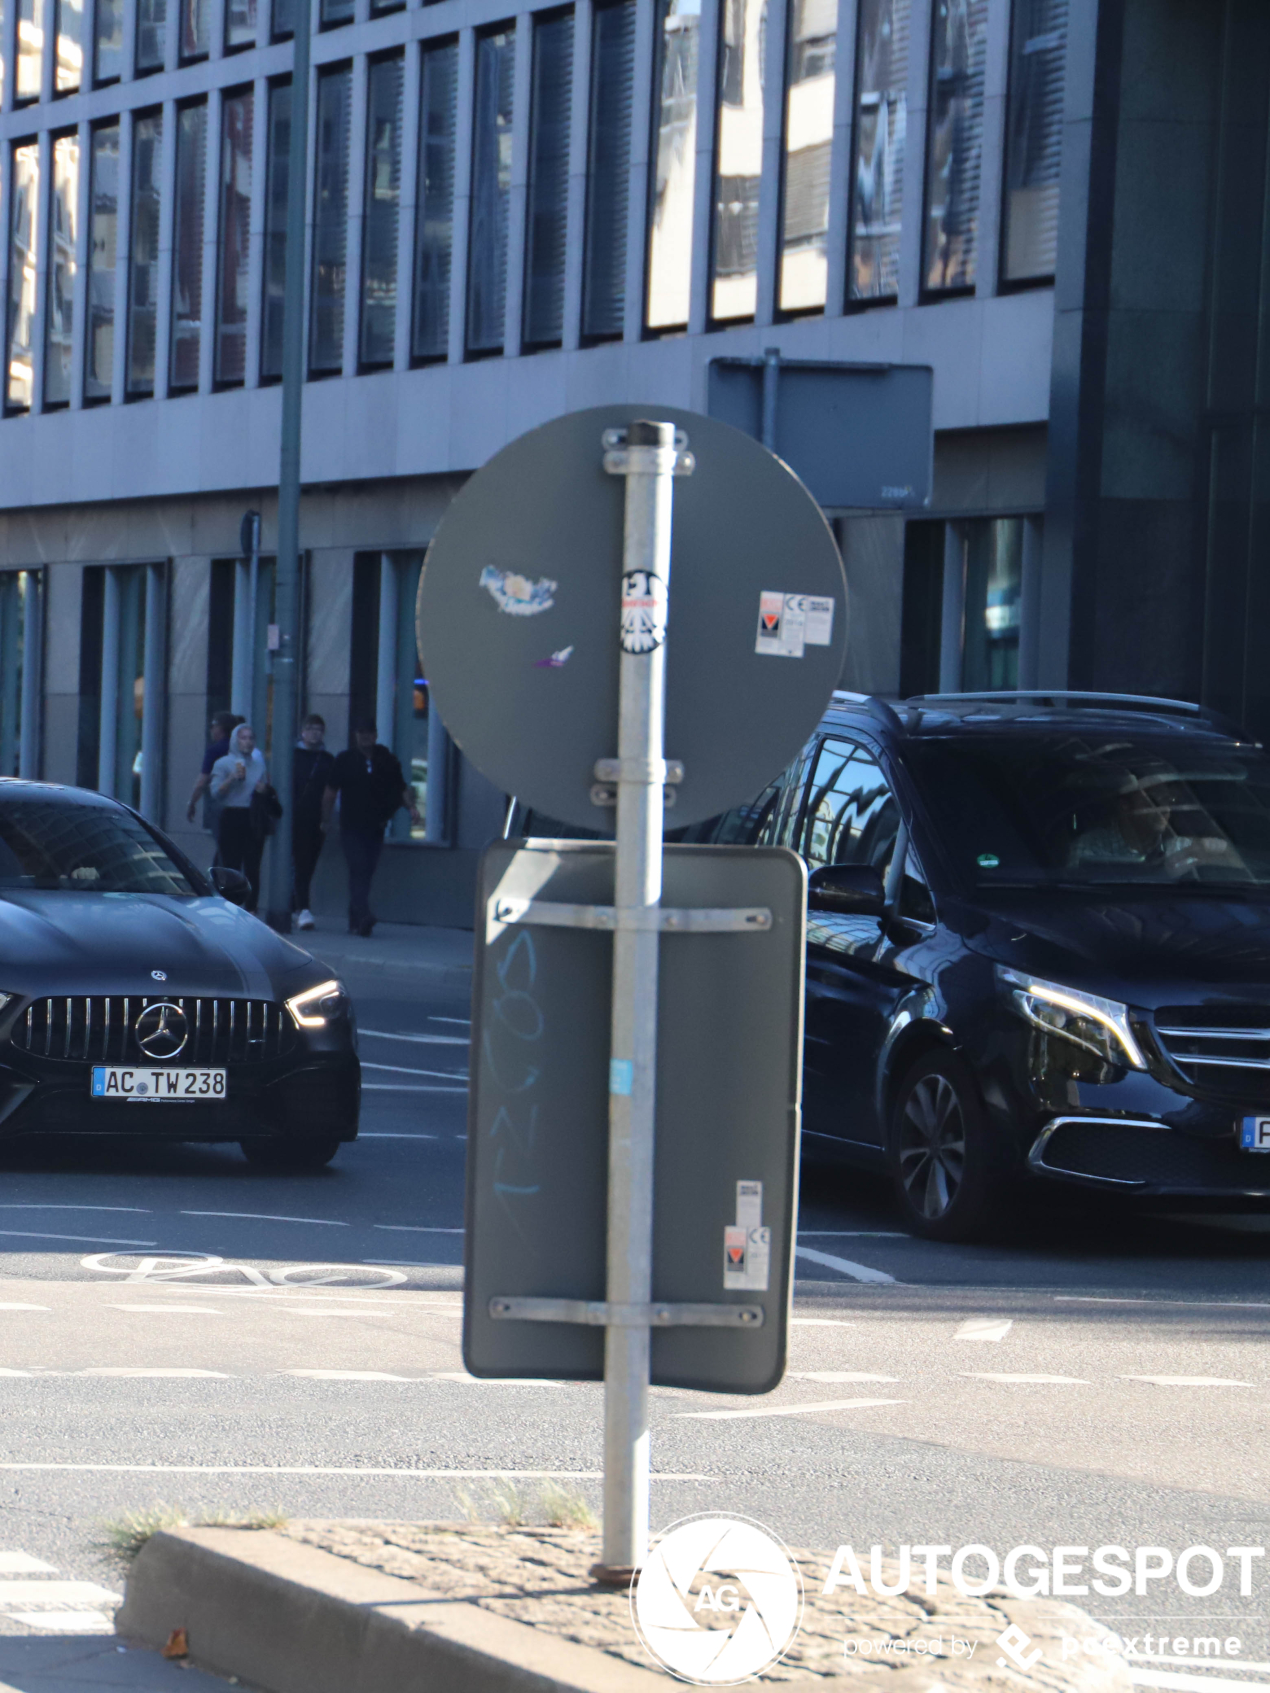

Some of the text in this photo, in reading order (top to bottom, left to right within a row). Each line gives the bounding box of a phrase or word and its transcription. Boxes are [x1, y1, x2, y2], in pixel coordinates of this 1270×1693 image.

[106, 1071, 134, 1093] AC
[151, 1072, 179, 1094] TW
[184, 1072, 225, 1095] 238
